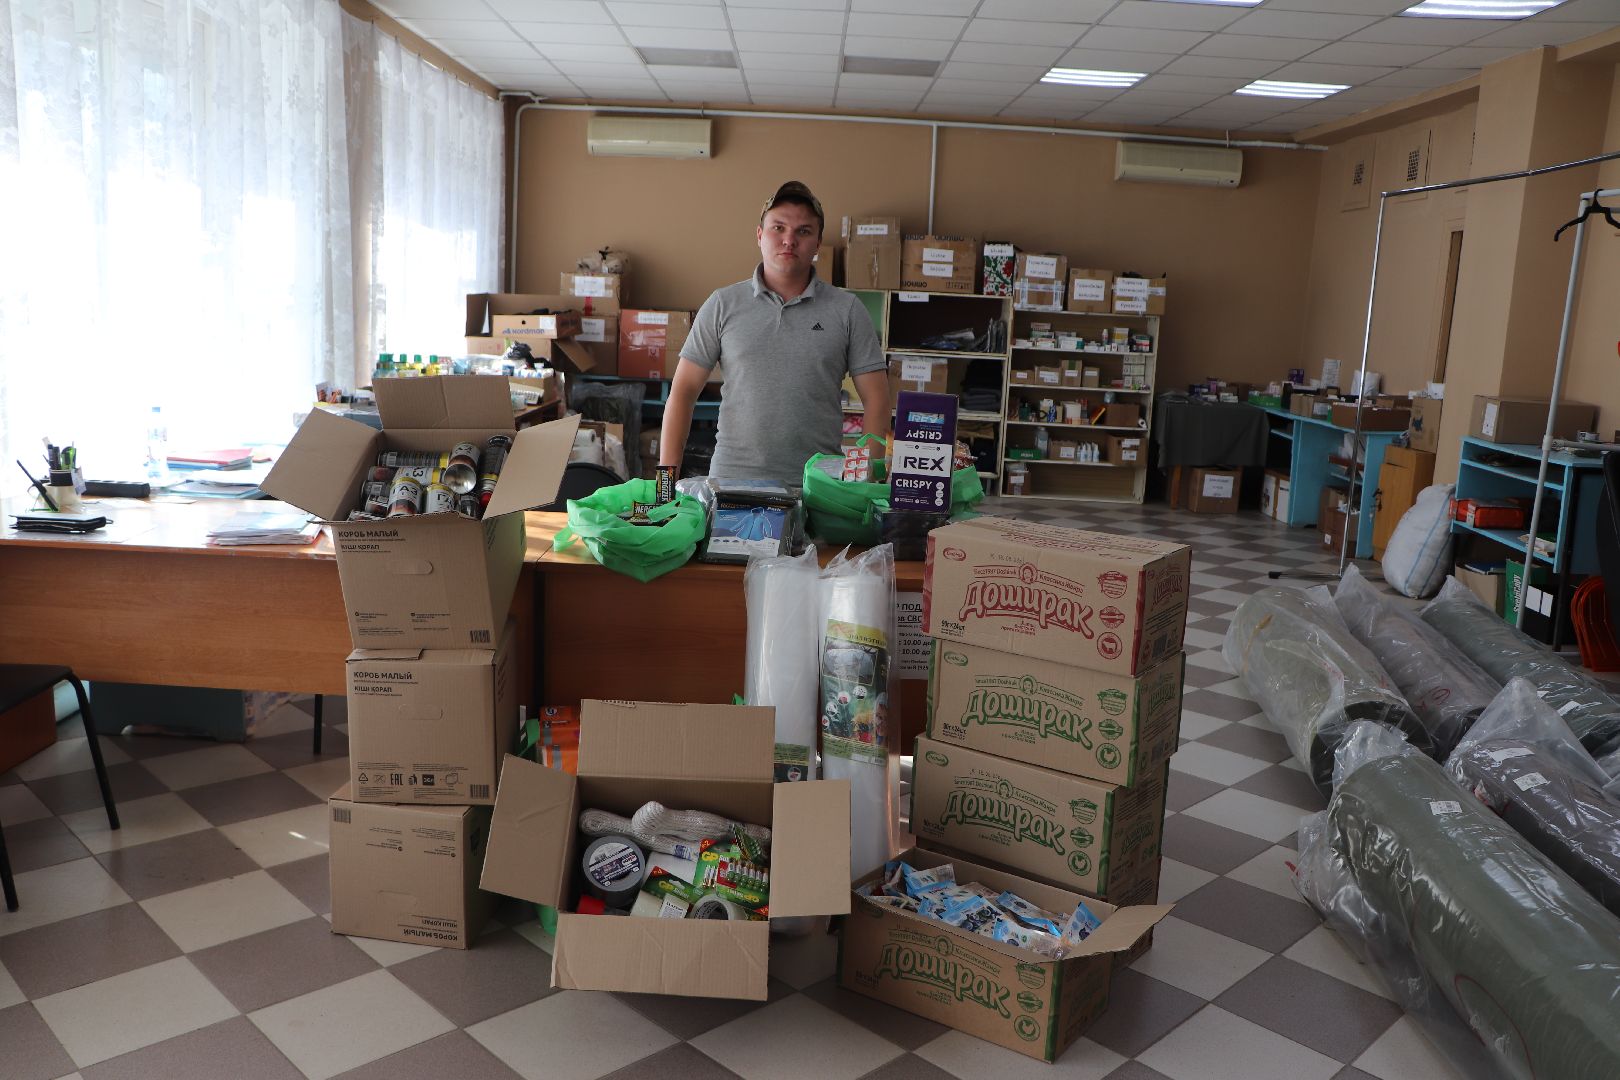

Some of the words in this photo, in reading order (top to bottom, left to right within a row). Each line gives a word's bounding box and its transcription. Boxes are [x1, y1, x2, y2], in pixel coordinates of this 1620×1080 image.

[906, 429, 942, 440] CRISPY
[903, 455, 945, 471] REX
[895, 478, 933, 490] CRISPY
[338, 530, 366, 538] КОРОБ
[366, 529, 399, 538] МАЛЫЙ
[958, 580, 1095, 639] Доширак
[353, 671, 380, 680] КОРОБ
[381, 671, 413, 680] МАЛЫЙ
[961, 688, 1094, 750] Доширак
[940, 790, 1066, 855] Доширак
[403, 928, 433, 939] МАЛЫЙ
[433, 932, 458, 941] КОРОБ
[874, 943, 1011, 1019] Доширак
